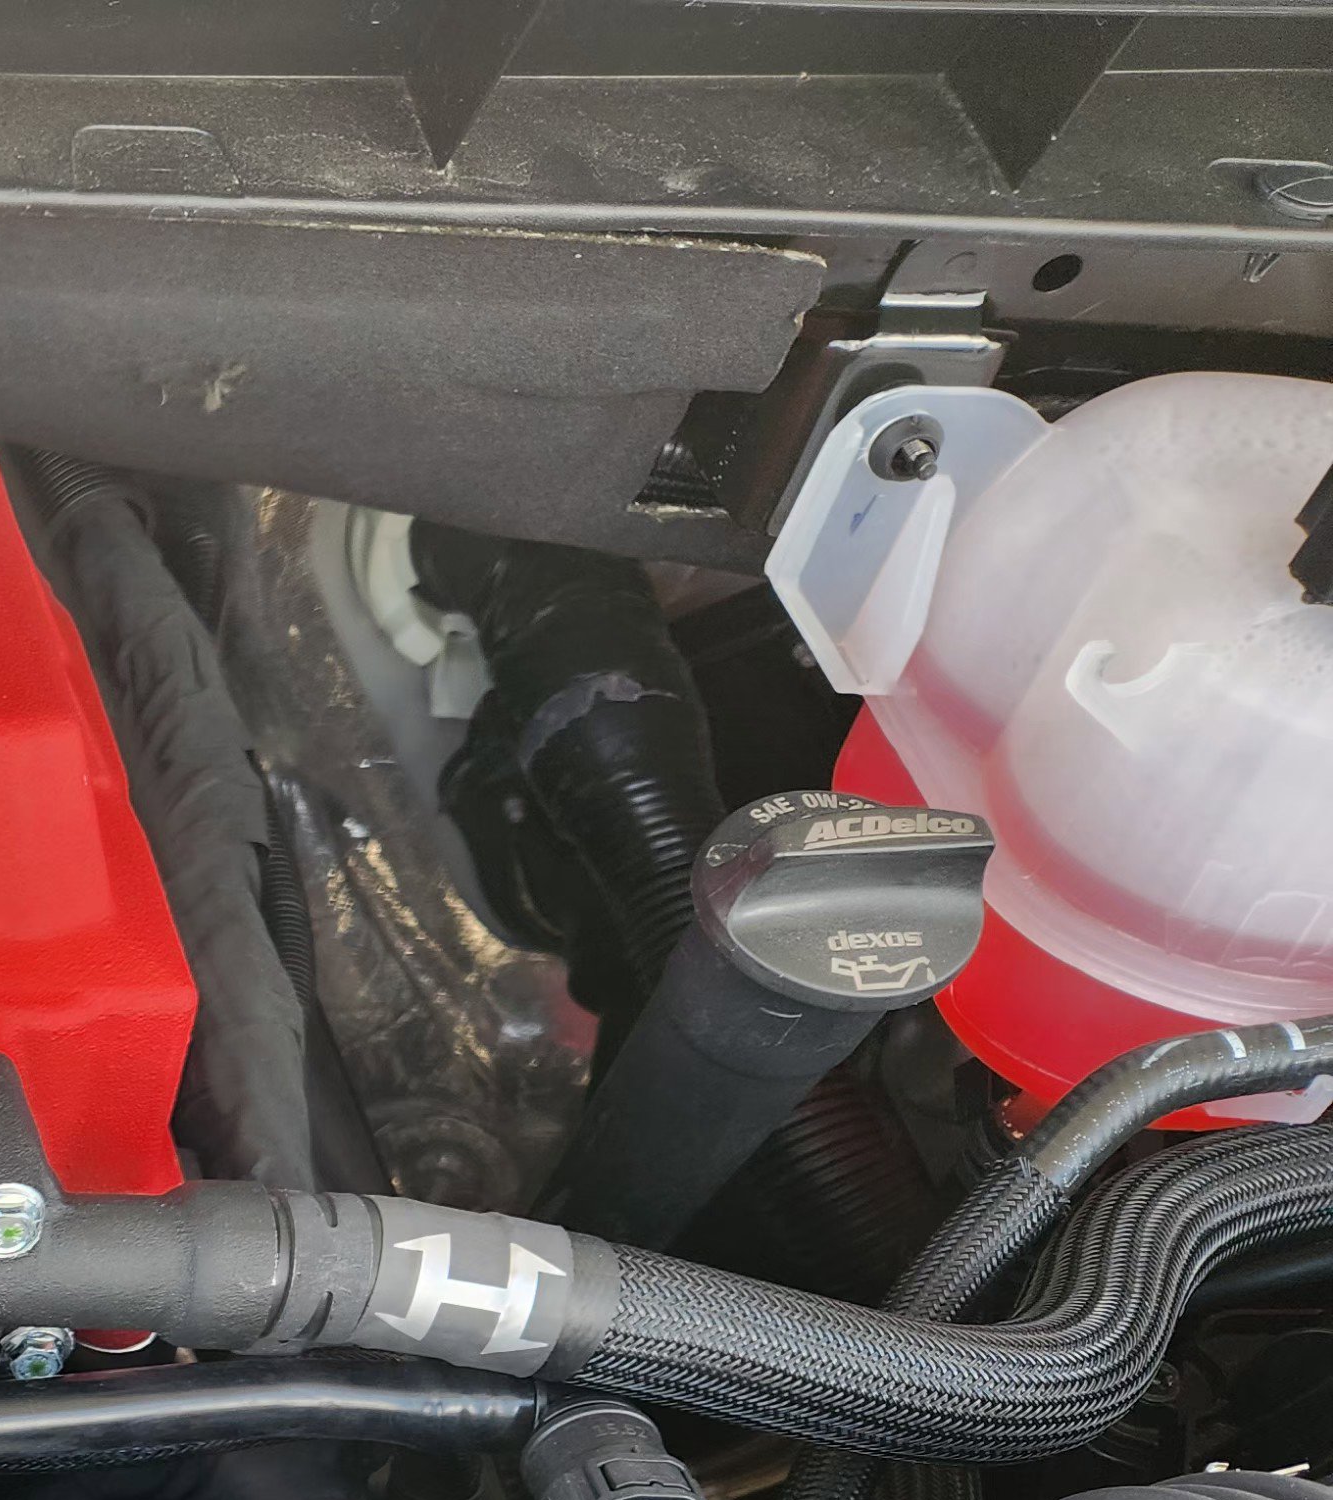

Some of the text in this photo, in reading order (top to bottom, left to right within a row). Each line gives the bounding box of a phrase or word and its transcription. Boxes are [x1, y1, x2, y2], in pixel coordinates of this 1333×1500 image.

[749, 796, 796, 825] SAE
[803, 813, 976, 844] ACDelco
[827, 929, 924, 952] dexos
